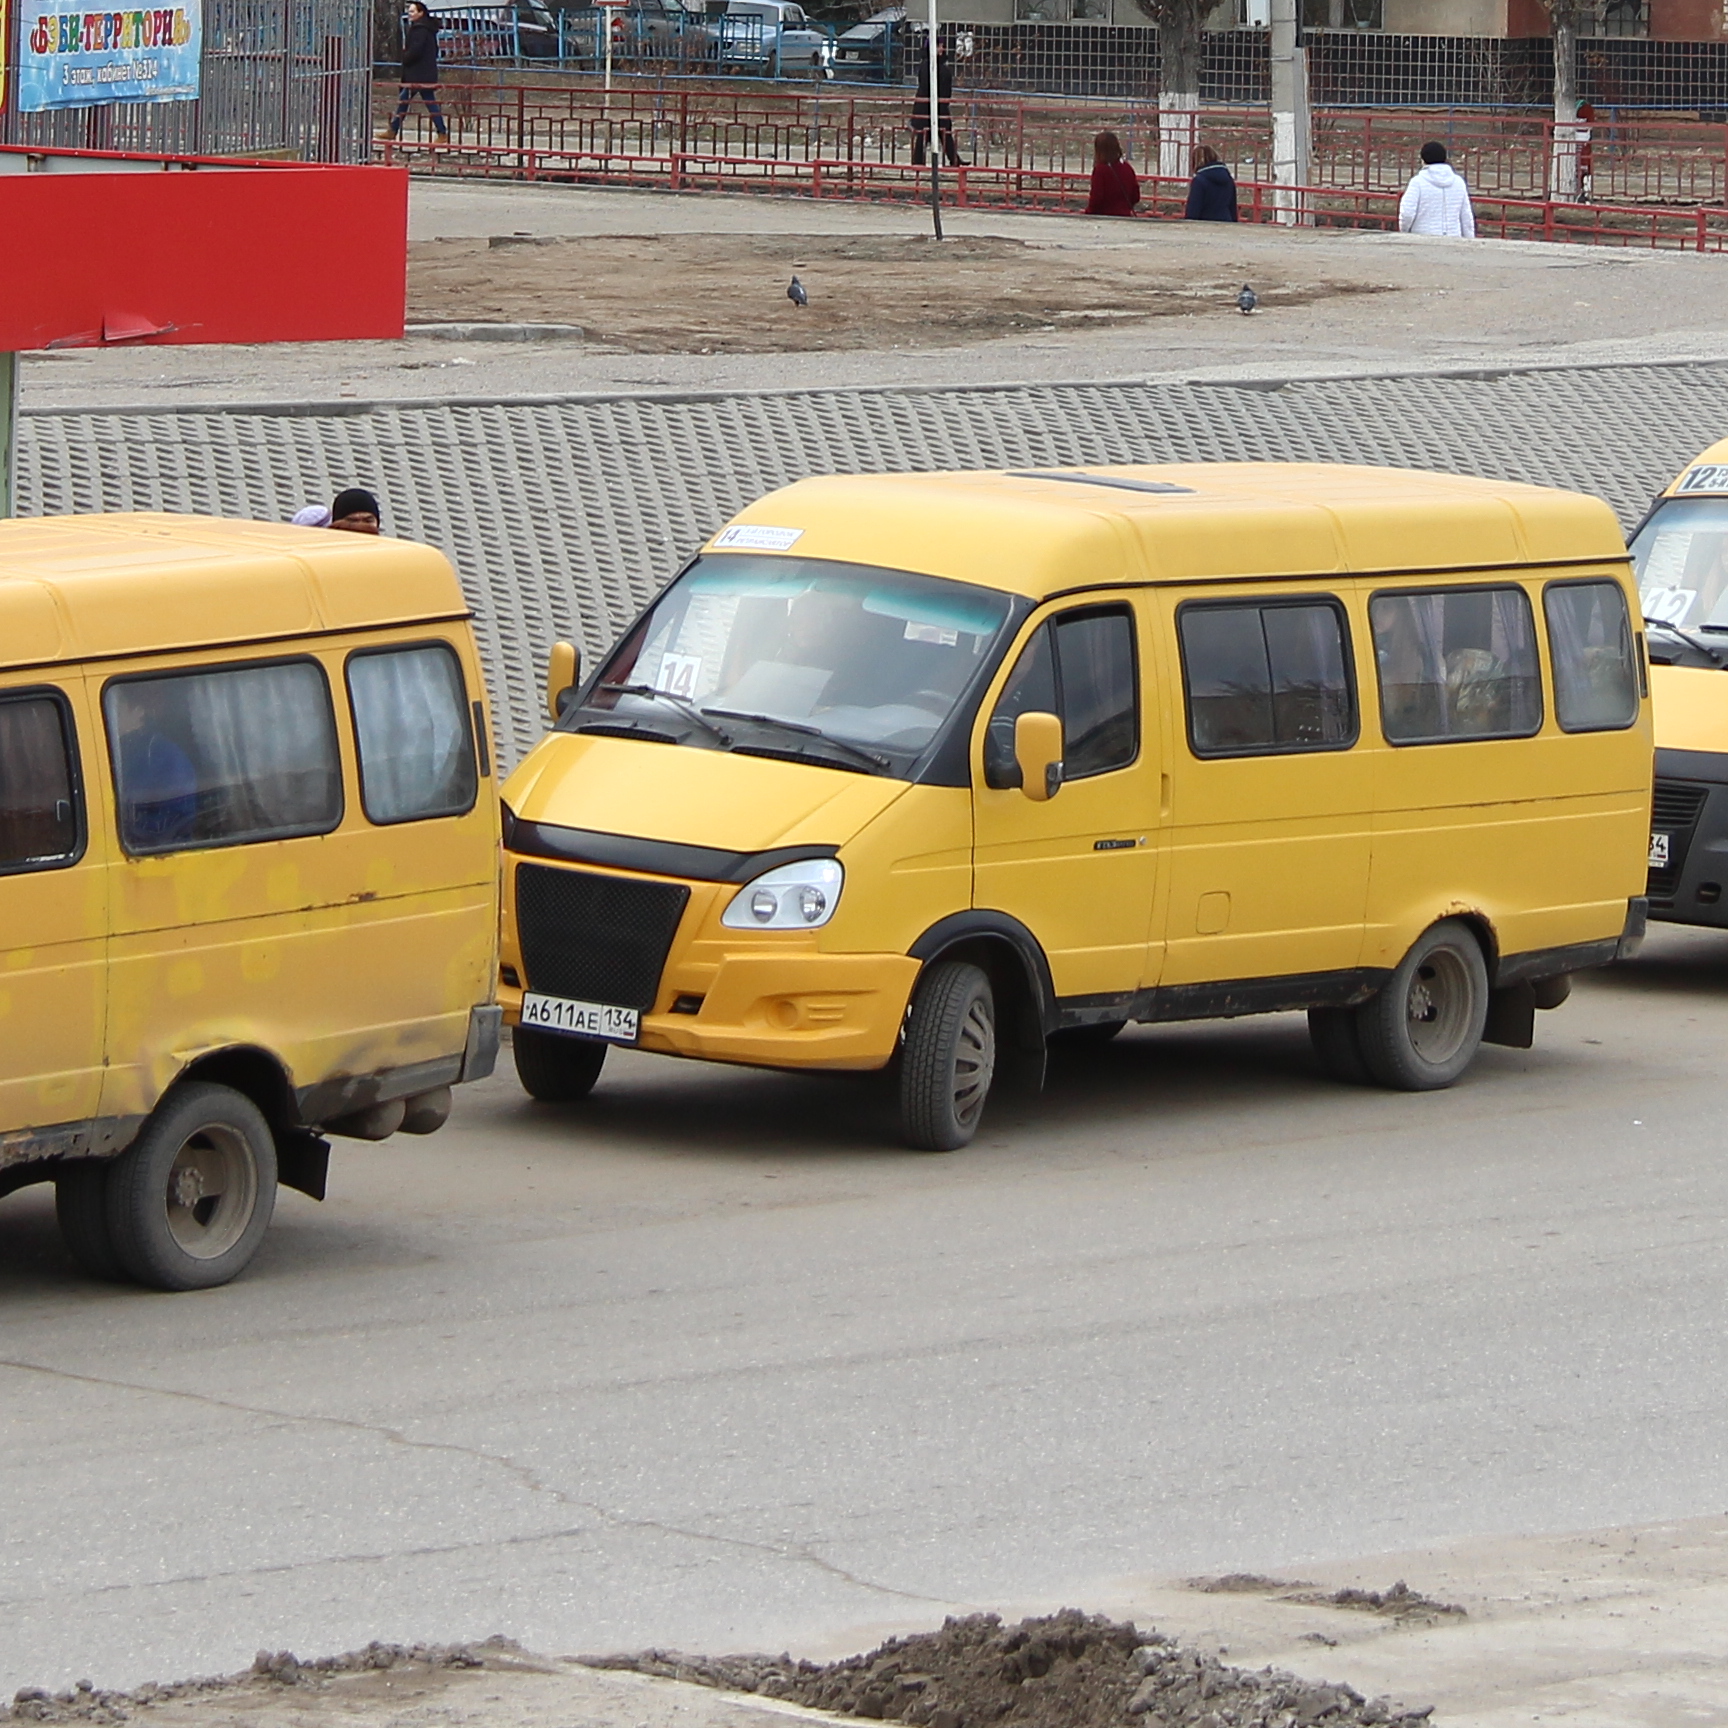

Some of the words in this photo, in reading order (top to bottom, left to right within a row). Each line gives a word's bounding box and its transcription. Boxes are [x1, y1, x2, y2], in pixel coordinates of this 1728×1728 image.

[62, 62, 69, 85] 3
[97, 60, 132, 83] кабинет
[1682, 466, 1718, 490] 12
[720, 528, 741, 543] 14
[1648, 591, 1688, 622] 12
[664, 661, 694, 696] 14
[528, 999, 599, 1030] А611АЕ
[605, 1008, 633, 1029] 134
